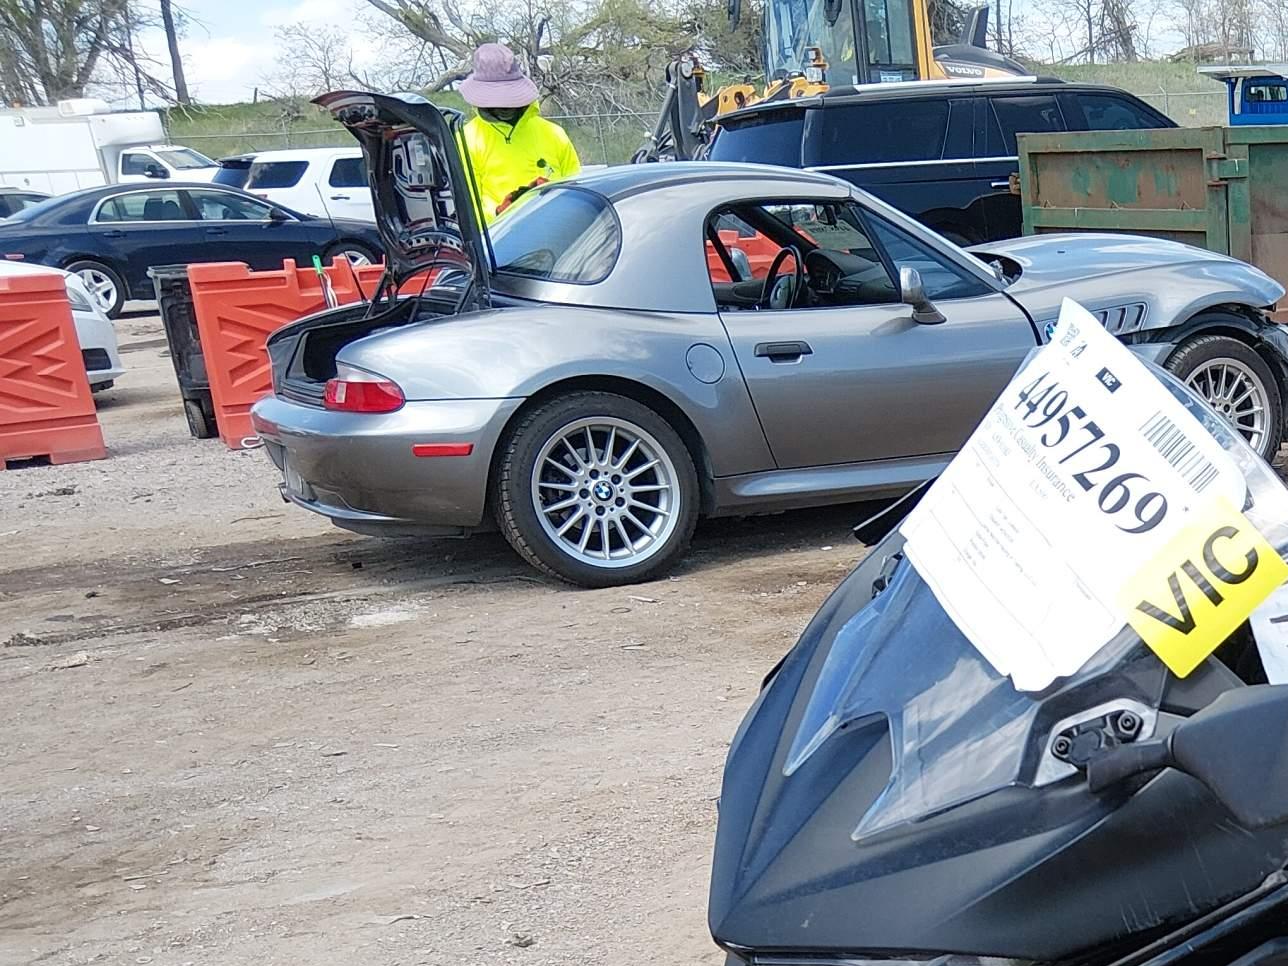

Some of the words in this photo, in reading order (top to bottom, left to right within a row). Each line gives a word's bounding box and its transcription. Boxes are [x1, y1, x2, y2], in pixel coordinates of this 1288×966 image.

[945, 66, 982, 75] VOLVO
[1013, 371, 1168, 534] 44957269
[1035, 455, 1076, 502] Insurance
[1136, 526, 1259, 636] VIC
